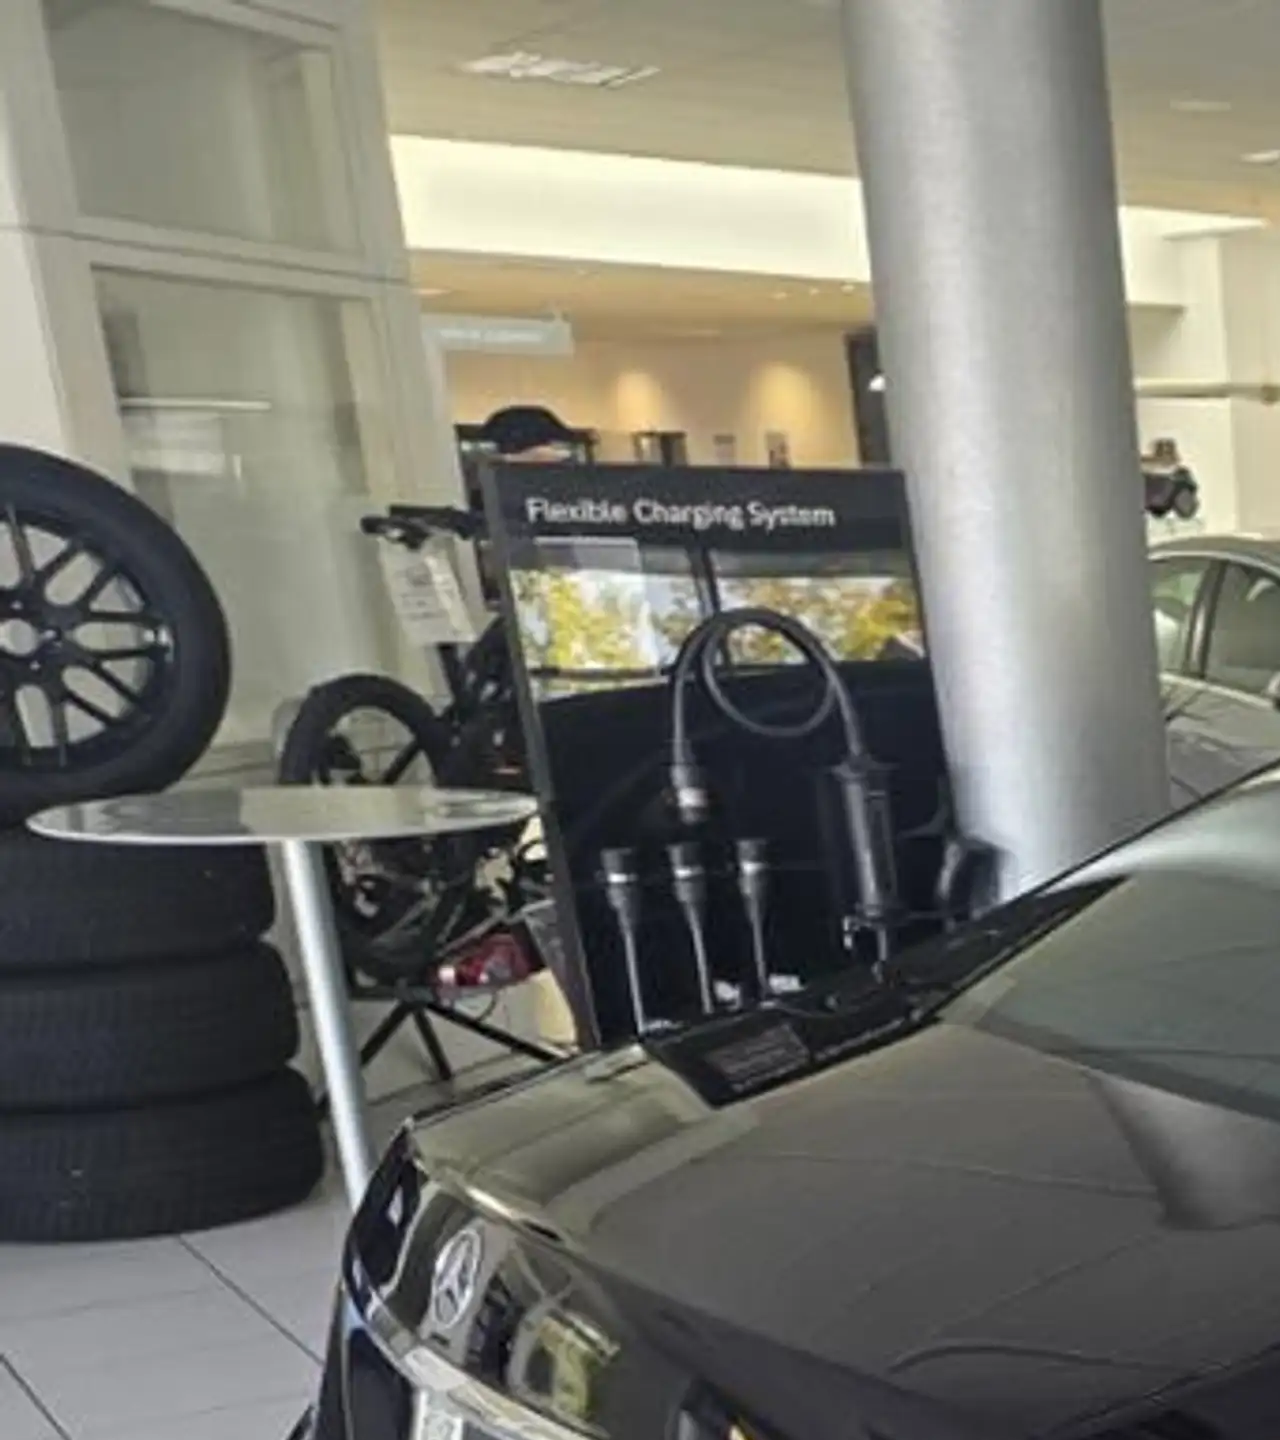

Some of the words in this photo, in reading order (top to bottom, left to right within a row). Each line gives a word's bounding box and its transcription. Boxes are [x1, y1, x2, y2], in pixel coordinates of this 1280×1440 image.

[525, 497, 628, 524] Flexible
[632, 499, 745, 531] Charging
[746, 500, 837, 534] System
